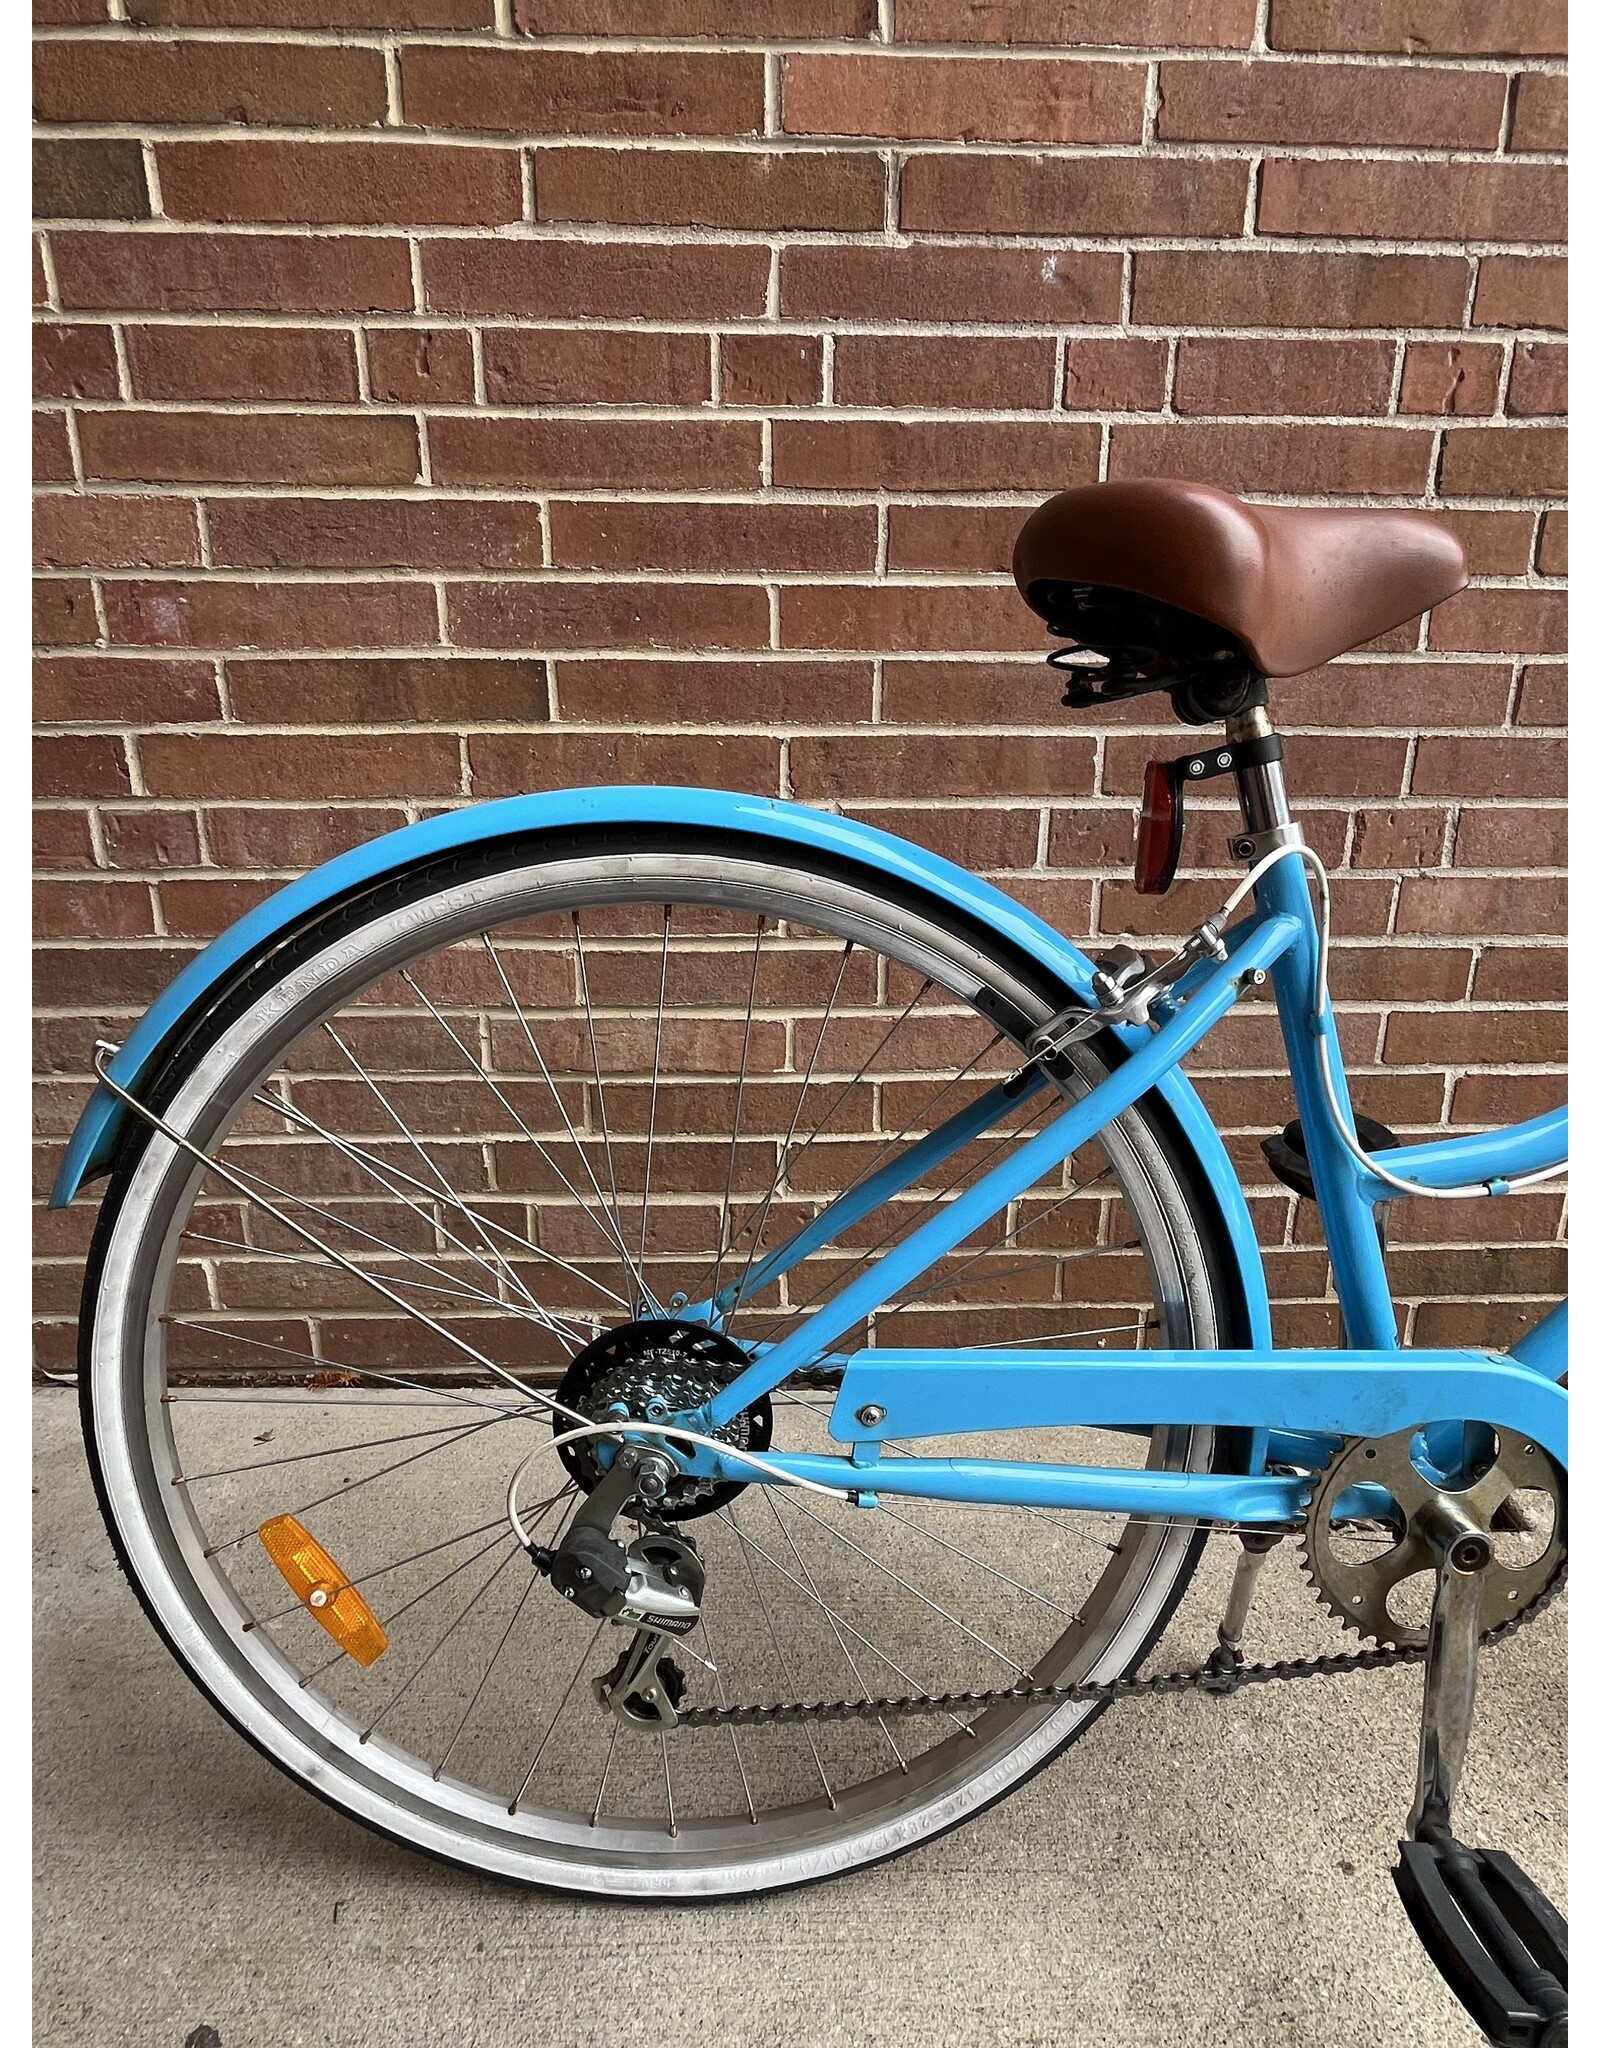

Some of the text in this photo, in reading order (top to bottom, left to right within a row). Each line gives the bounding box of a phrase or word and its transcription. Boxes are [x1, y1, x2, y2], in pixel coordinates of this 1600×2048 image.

[255, 886, 486, 1026] KENDA KWEST
[646, 1614, 692, 1630] SHIMANO
